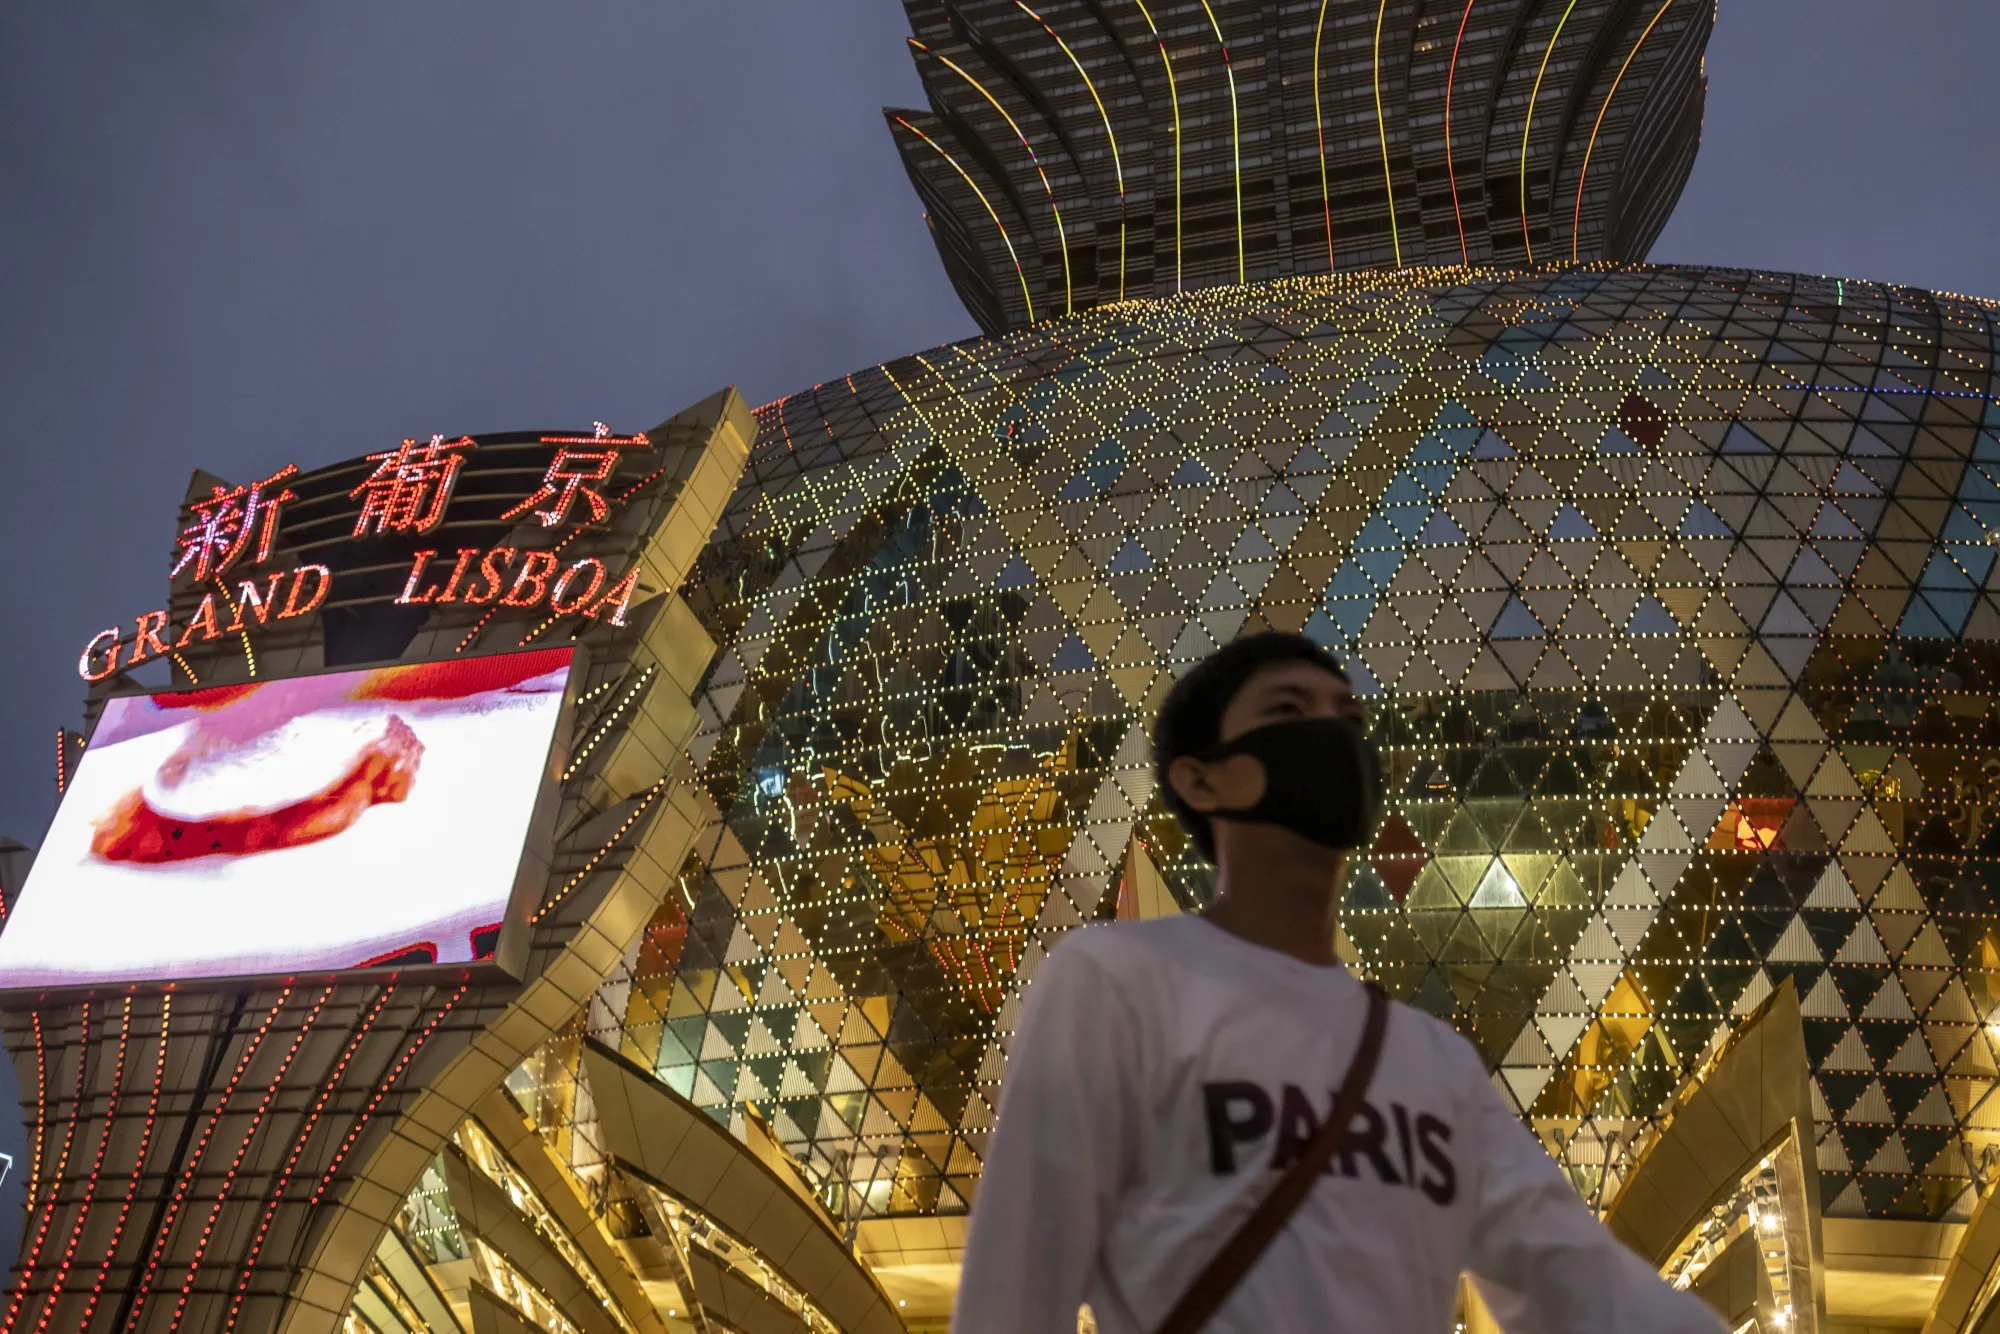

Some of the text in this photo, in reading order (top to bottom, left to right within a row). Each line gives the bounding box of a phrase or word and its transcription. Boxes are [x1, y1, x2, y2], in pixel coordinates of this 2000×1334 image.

[169, 421, 650, 581] 新葡京
[78, 547, 641, 682] GRAND LISBOA
[1202, 1080, 1457, 1207] PARIS
